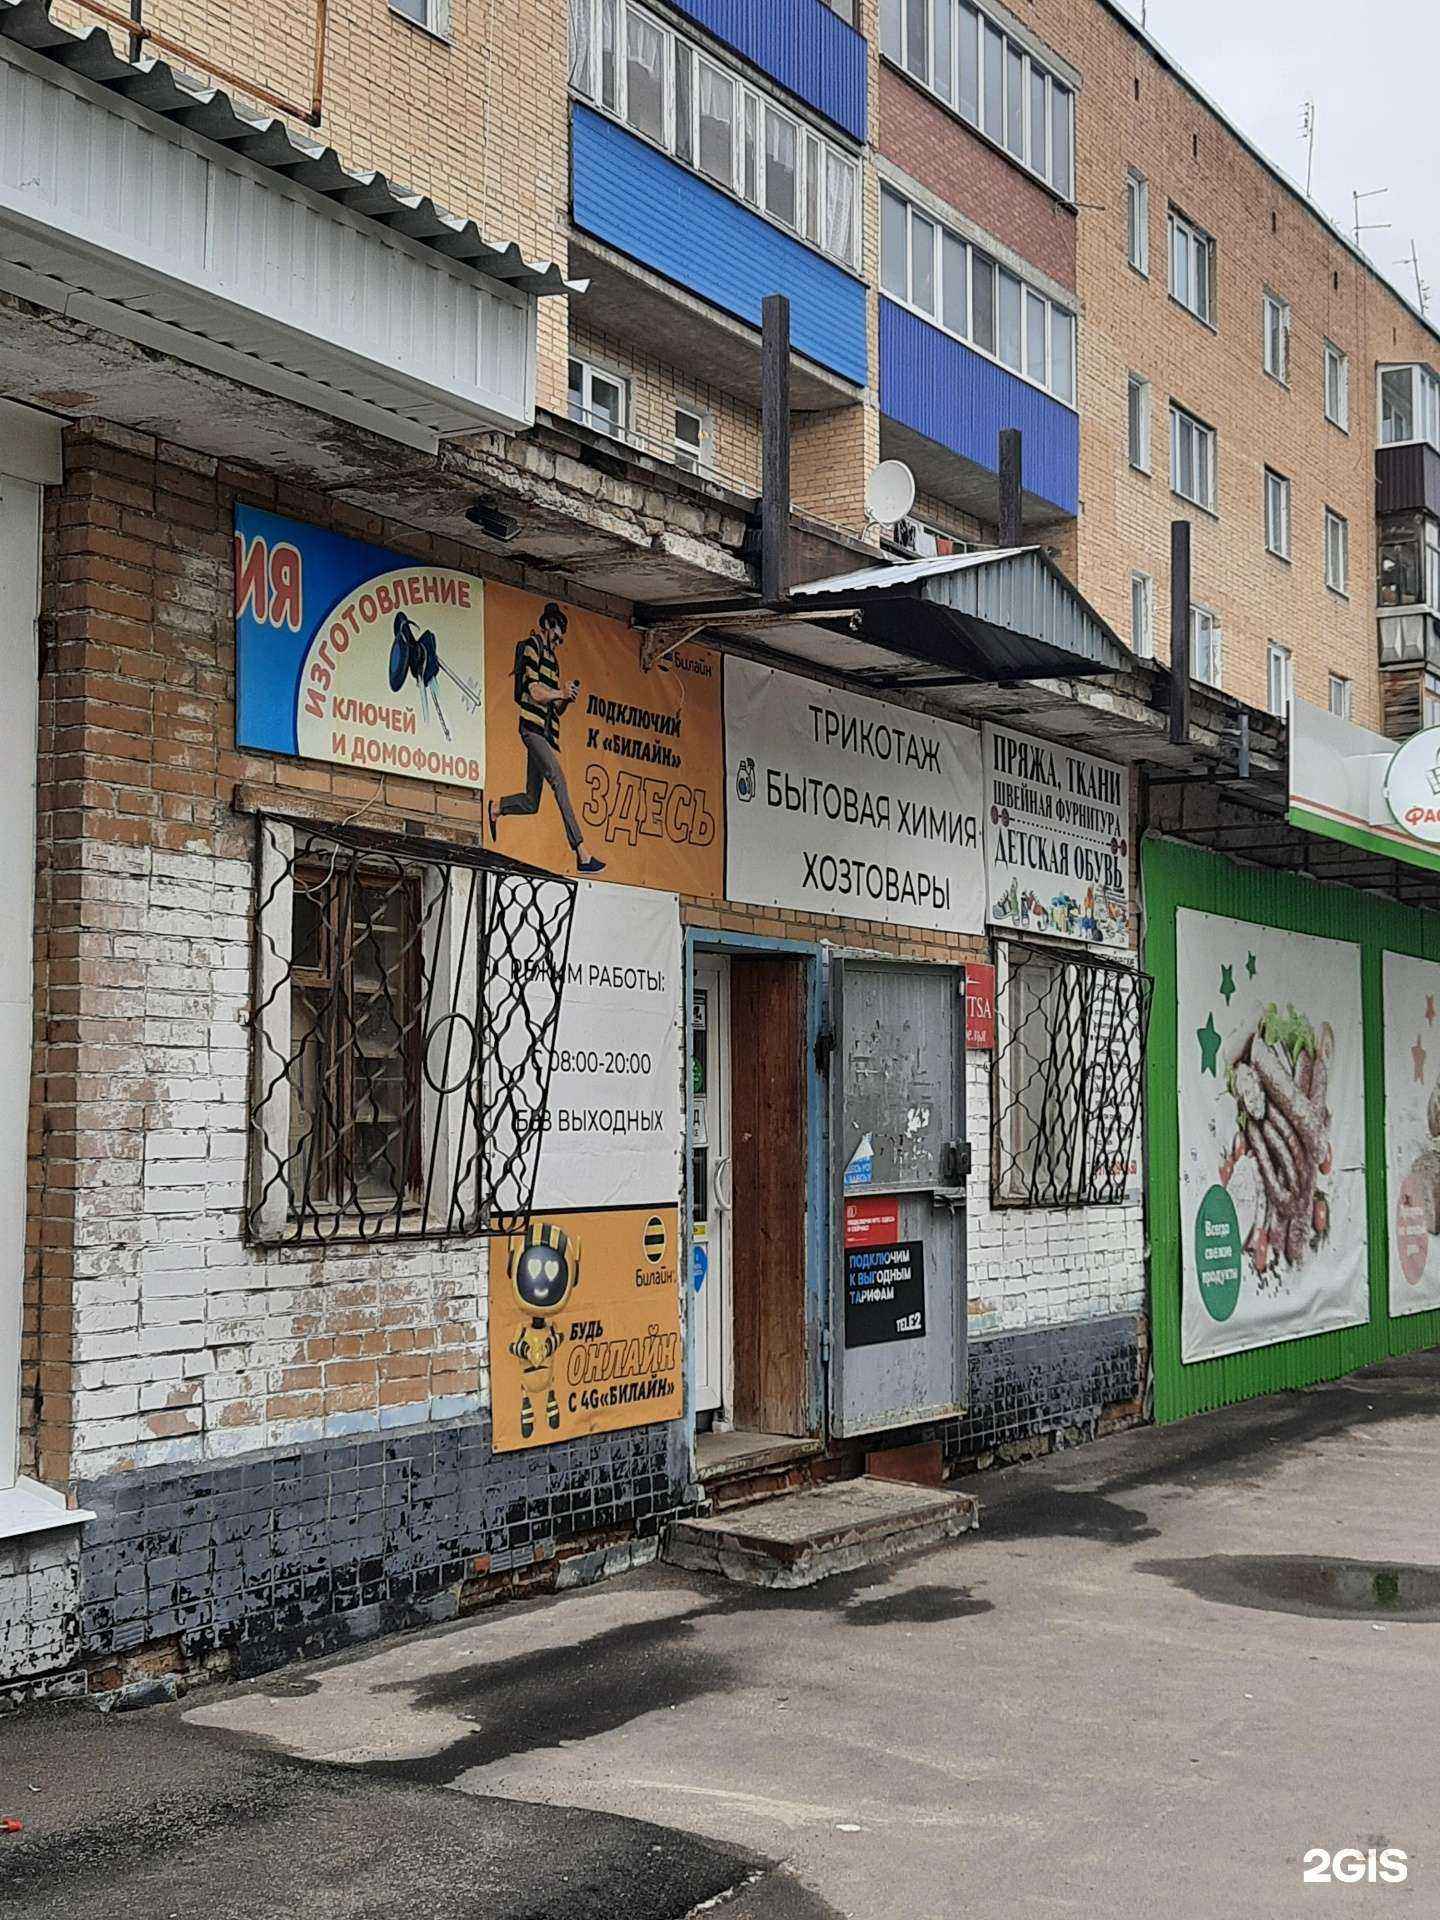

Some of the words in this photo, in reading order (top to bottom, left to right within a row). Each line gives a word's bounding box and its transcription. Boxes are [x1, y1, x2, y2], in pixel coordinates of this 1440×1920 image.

[305, 576, 472, 719] ИЗГОТОВЛЕНИЕ
[332, 696, 416, 735] КЛЮЧЕЙ
[332, 732, 346, 755] И
[351, 736, 480, 782] ДОМОФОНОВ
[586, 728, 600, 750] К
[602, 734, 682, 769] «БИЛАЙН»
[808, 705, 942, 774] ТРИКОТАЖ
[993, 734, 1062, 792] ПРЯЖА,
[1066, 757, 1122, 806] ТКАНИ
[582, 764, 716, 846] ЗДЕСЬ
[766, 769, 892, 831] БЫТОВАЯ
[897, 799, 977, 849] ХИМИЯ
[993, 780, 1053, 819] ШВЕЙНАЯ
[1056, 798, 1122, 837] ФУРНИТУРА
[994, 827, 1069, 876] ДЕТСКАЯ
[1074, 845, 1124, 888] ОБУВЬ
[802, 851, 951, 910] ХОЗТОВАРЫ
[589, 964, 666, 992] РАБОТЫ:
[549, 1050, 651, 1074] 08:00-20:00
[558, 1109, 664, 1135] ВЫХОДНЫХ
[849, 1249, 911, 1270] ПОДКЛЮЧИМ
[849, 1272, 856, 1287] К
[857, 1267, 912, 1286] ВЫГОДНЫМ
[849, 1286, 895, 1305] ТАРИФАМ
[569, 1320, 604, 1342] БУДЬ
[895, 1311, 922, 1333] TELE2
[566, 1323, 678, 1387] ОНЛАЙН
[568, 1392, 577, 1412] С
